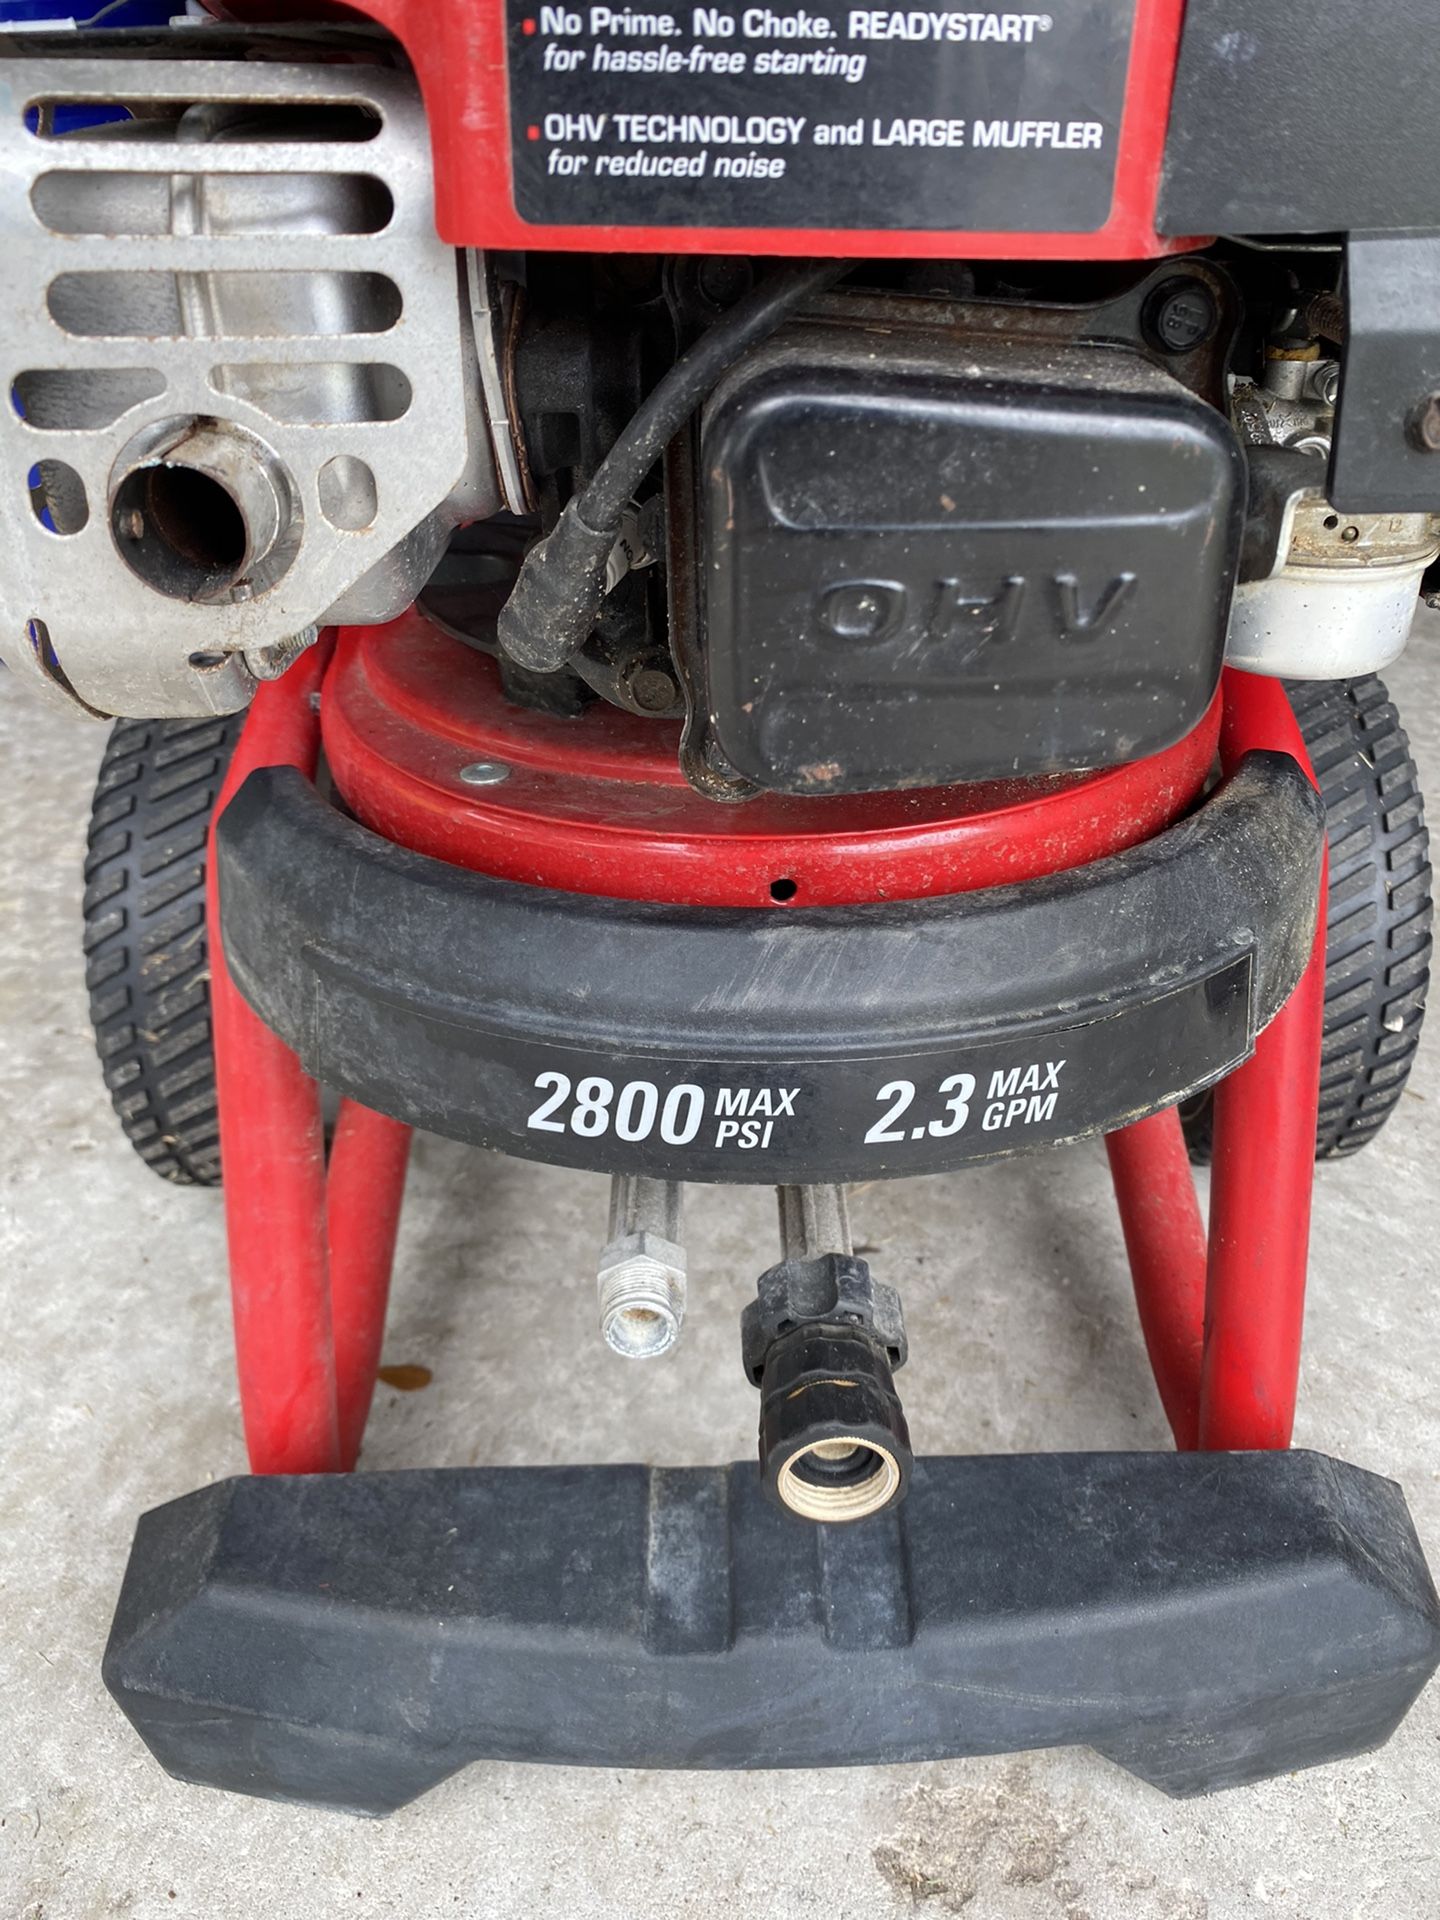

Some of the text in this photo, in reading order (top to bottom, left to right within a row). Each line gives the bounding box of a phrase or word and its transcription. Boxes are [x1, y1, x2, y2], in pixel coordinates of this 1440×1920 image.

[541, 6, 582, 35] No
[590, 6, 682, 37] Prime.
[693, 7, 735, 37] No
[742, 8, 837, 39] Choke.
[544, 43, 867, 83] for hassle-free starting
[545, 114, 1104, 150] OHV TECHNOLOGY and LARGE MUFFLER
[548, 149, 787, 179] for reduced noise
[817, 571, 1137, 643] OHV
[528, 1072, 800, 1145] 2800 MAX
[864, 1060, 1067, 1144] 2.3 MAX
[982, 1093, 1059, 1131] GPM
[715, 1120, 774, 1149] PSI
